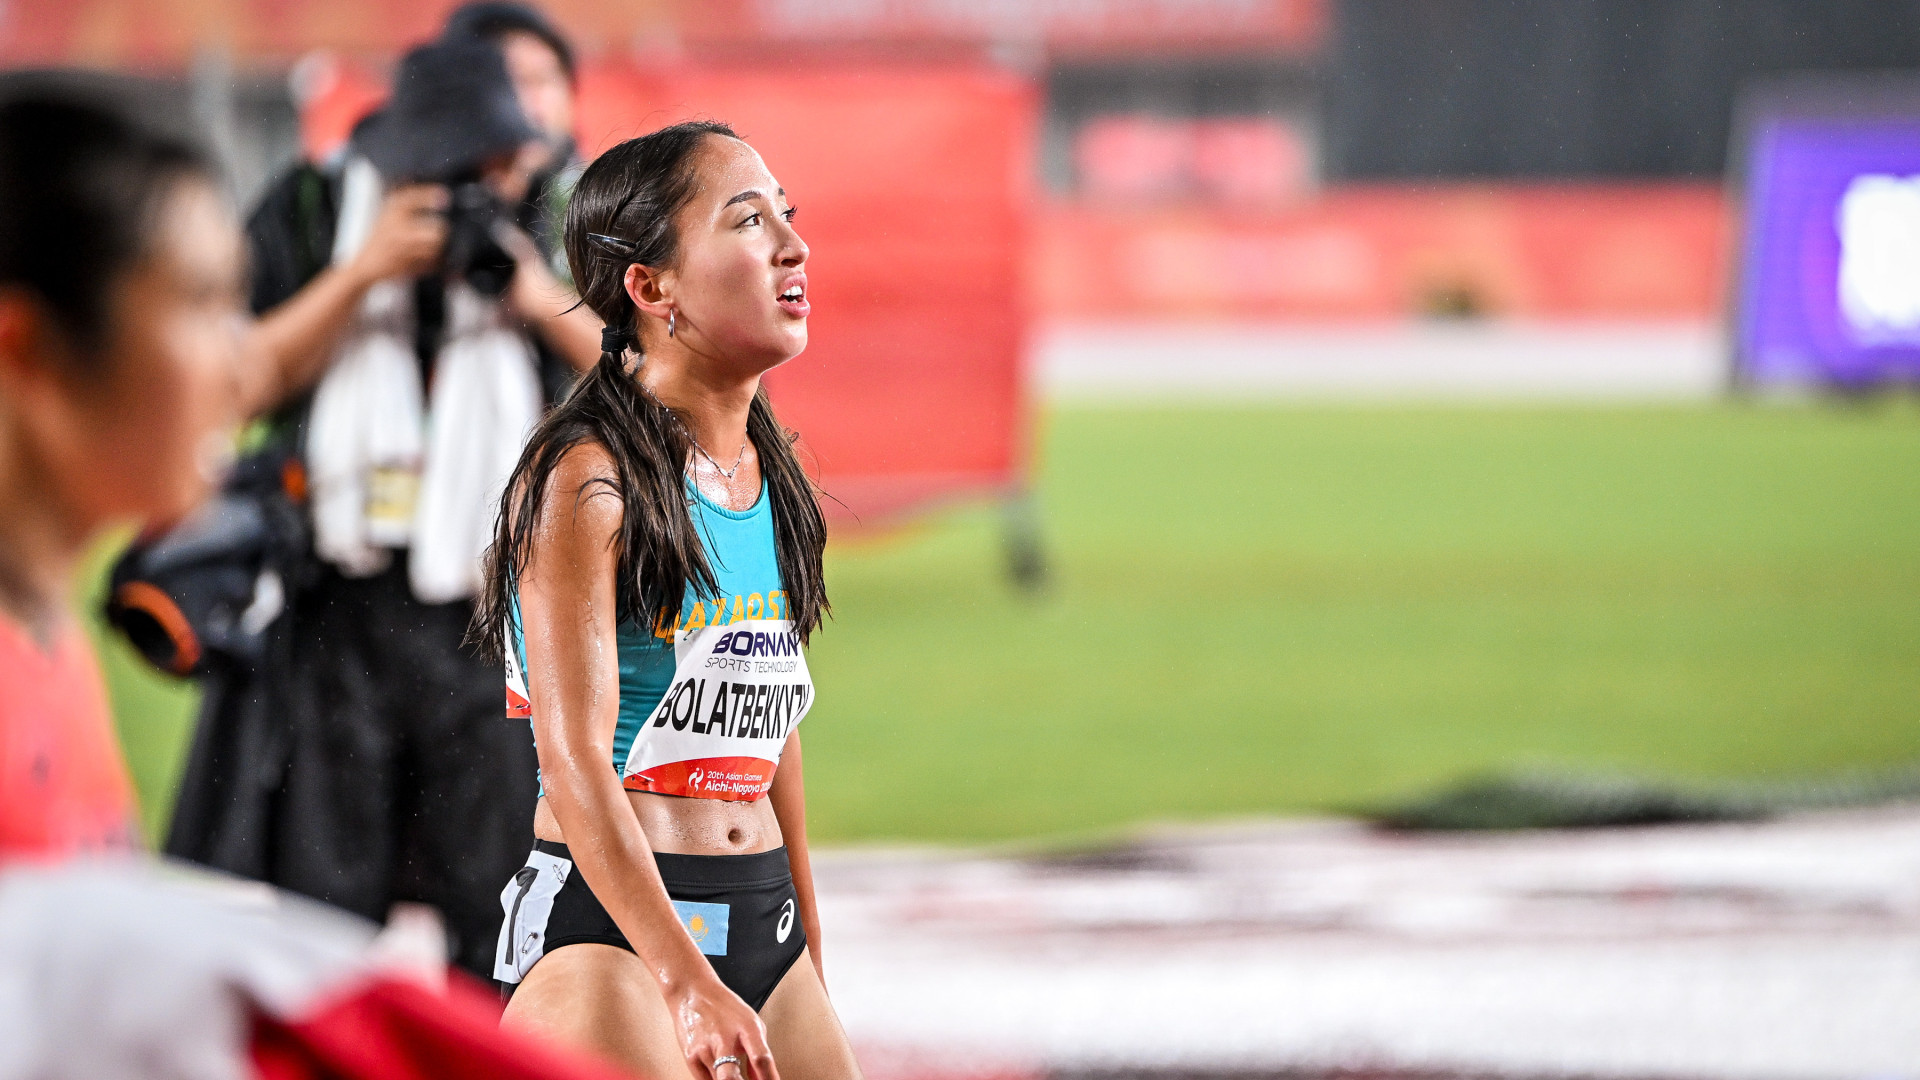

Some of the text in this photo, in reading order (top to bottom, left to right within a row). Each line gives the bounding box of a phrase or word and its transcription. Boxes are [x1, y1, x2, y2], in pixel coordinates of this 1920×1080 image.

[712, 631, 798, 657] BORNAN
[705, 657, 798, 673] SPORTS TECHNOLOGY
[707, 770, 762, 781] 20th Asian Games
[704, 780, 760, 795] Aichi-Nagoya
